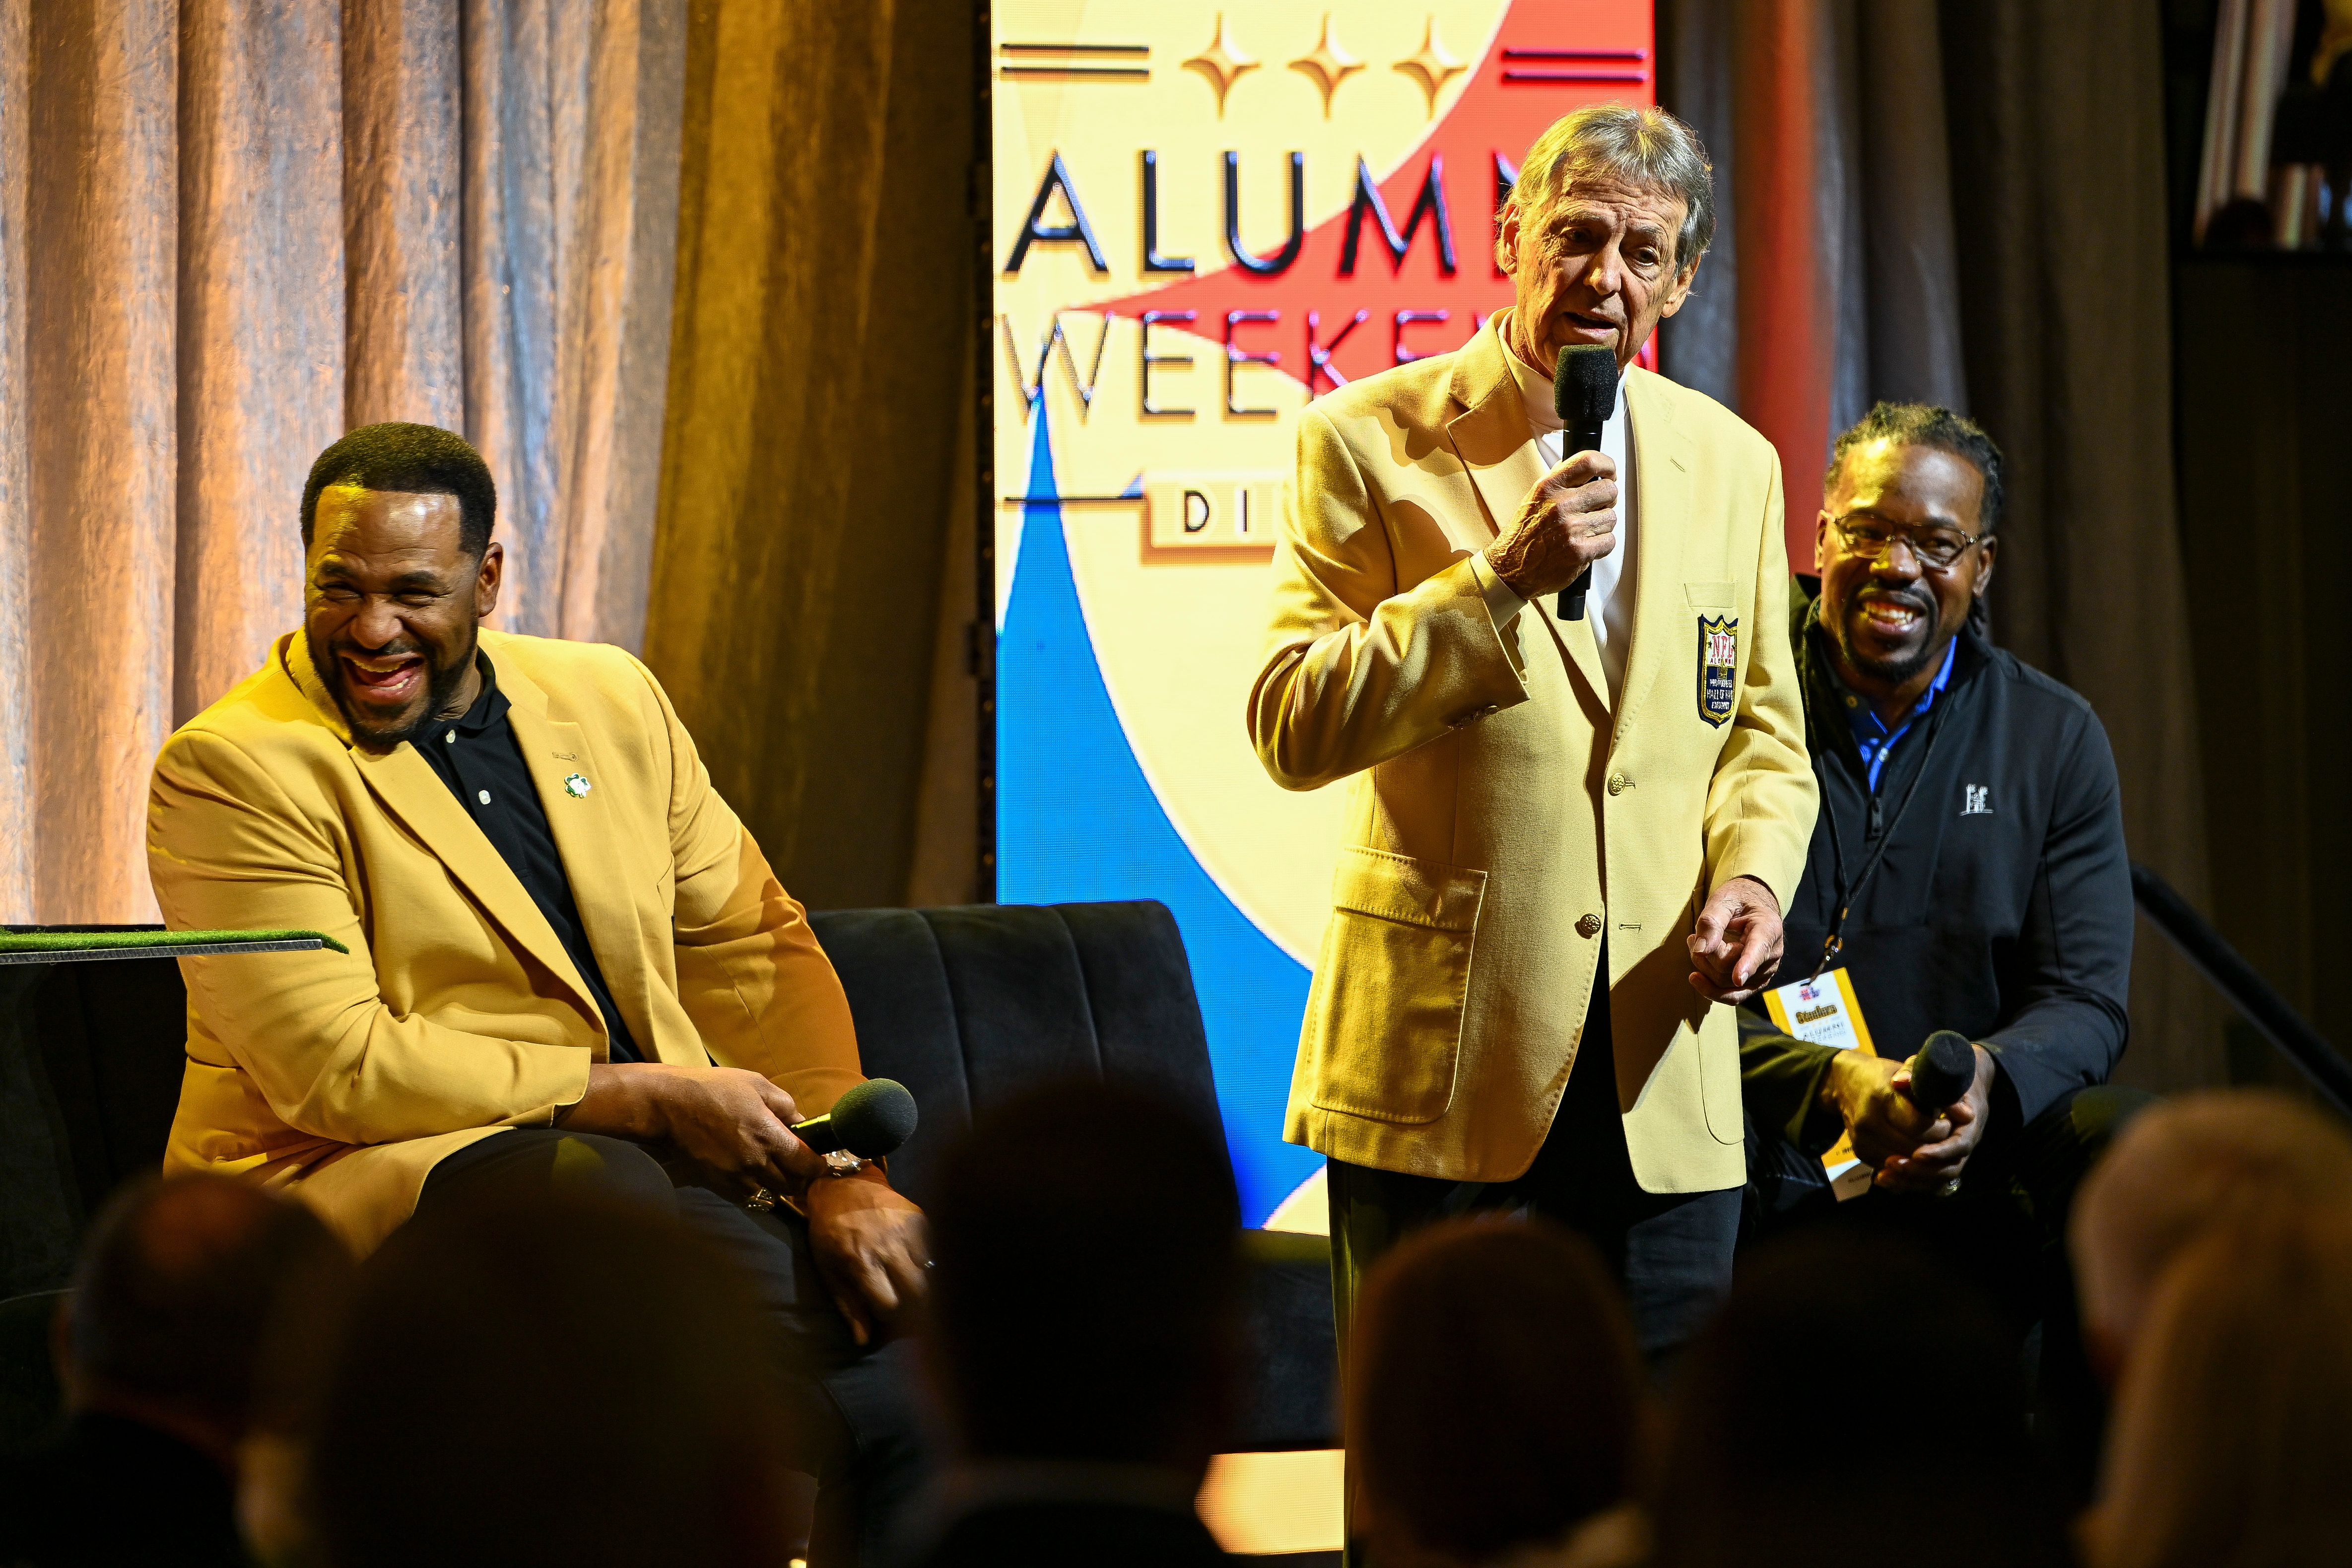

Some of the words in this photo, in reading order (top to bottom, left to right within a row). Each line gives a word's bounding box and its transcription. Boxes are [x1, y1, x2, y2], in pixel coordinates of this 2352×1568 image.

[1003, 148, 1519, 276] ALUM
[1183, 488, 1249, 534] DI
[1712, 635, 1733, 658] NFL
